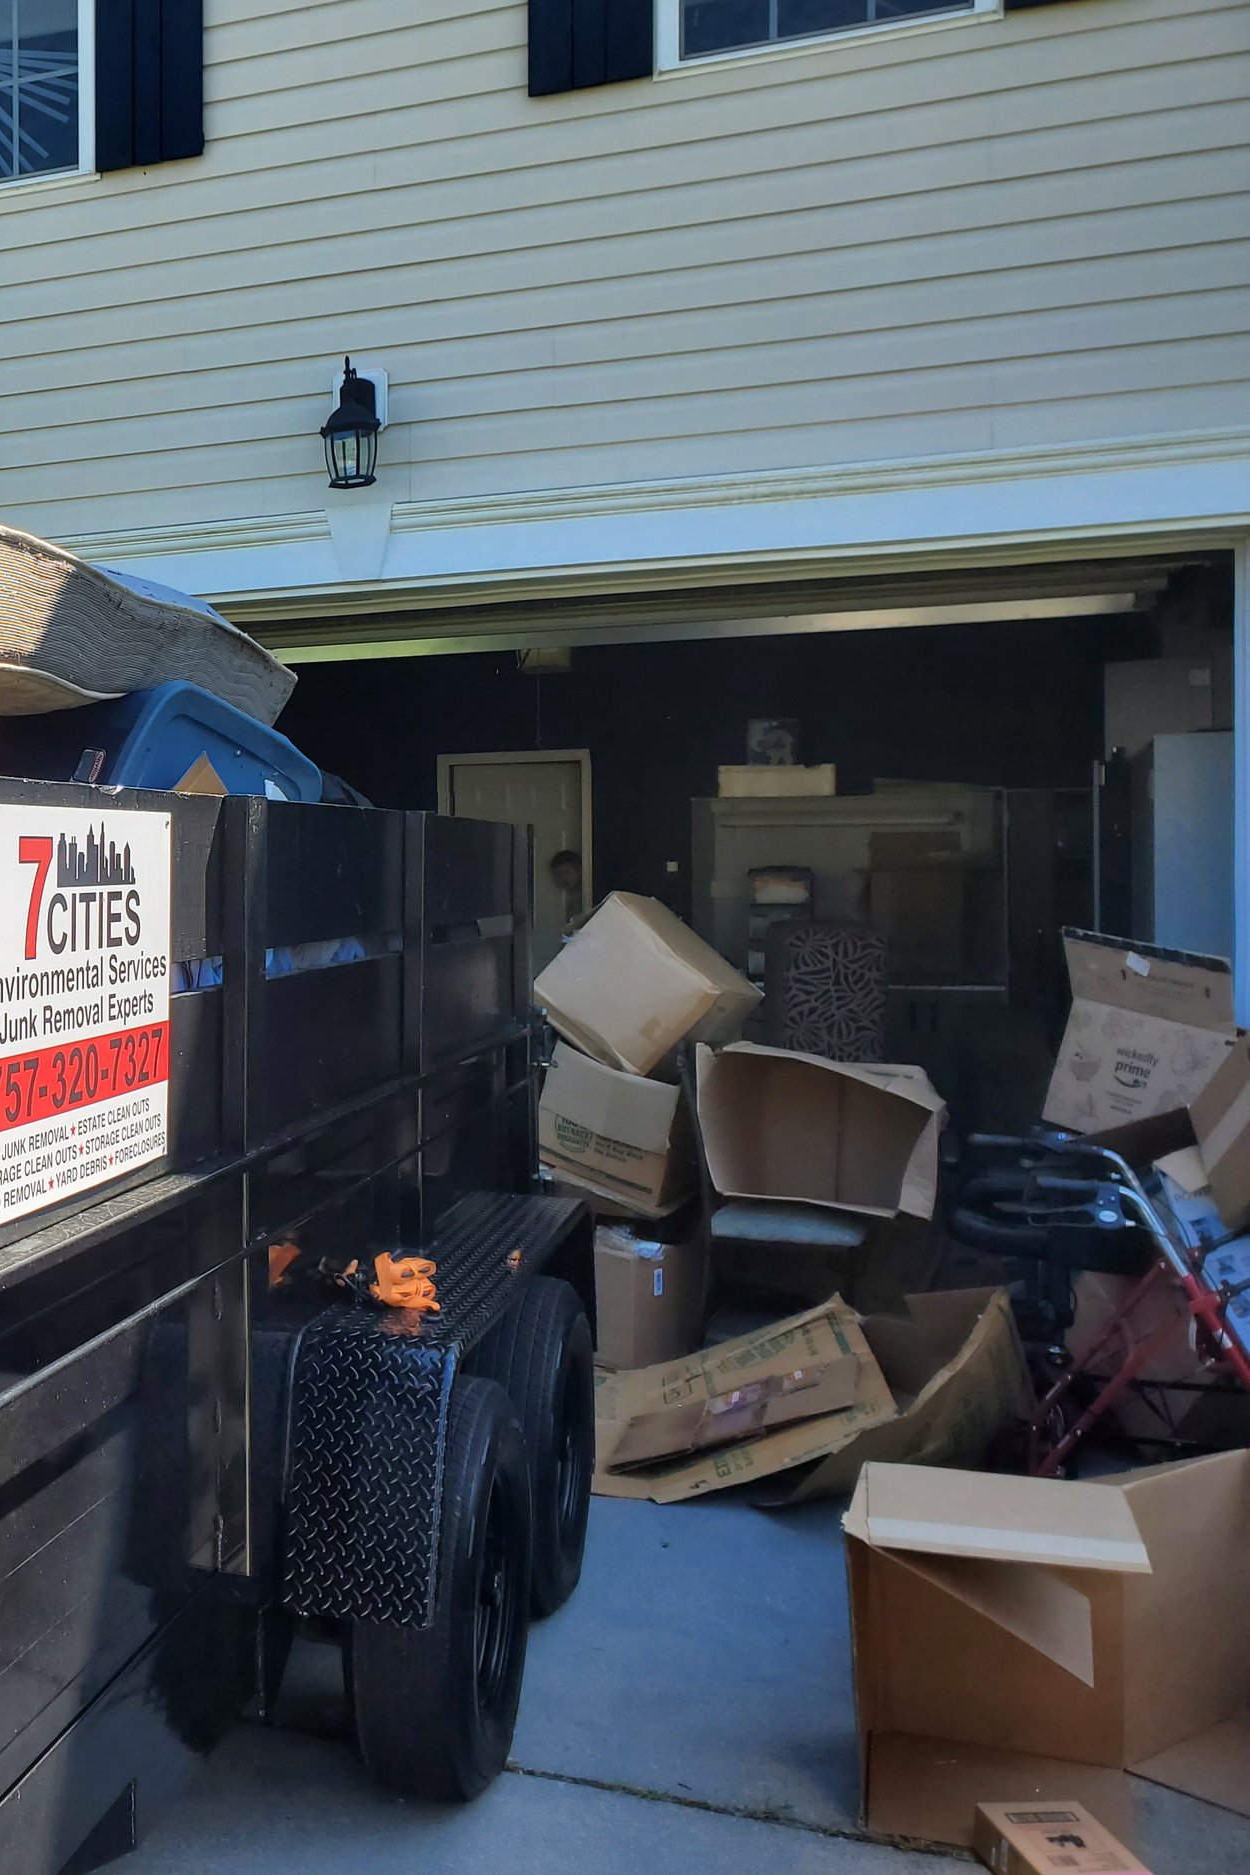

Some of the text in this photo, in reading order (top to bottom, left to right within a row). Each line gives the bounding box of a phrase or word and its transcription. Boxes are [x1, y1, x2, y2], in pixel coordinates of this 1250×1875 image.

[18, 835, 53, 961] 7
[46, 889, 141, 955] CITIES
[108, 950, 167, 985] Services
[43, 995, 104, 1035] Removal
[108, 989, 154, 1026] Experts
[1115, 1061, 1151, 1078] prime
[1, 1097, 150, 1161] JUNK REMOVAL ESTATE CLEAN OUTS
[24, 1153, 53, 1177] CLEAN
[55, 1144, 78, 1166] OUTS
[85, 1130, 121, 1155] STORAGE
[121, 1121, 144, 1142] CLEAN
[144, 1112, 162, 1134] OUTS
[3, 1179, 47, 1208] REMOVAL
[55, 1167, 78, 1189] YARD
[79, 1155, 108, 1180] DEBRIS
[114, 1131, 166, 1166] FORECLOSURES
